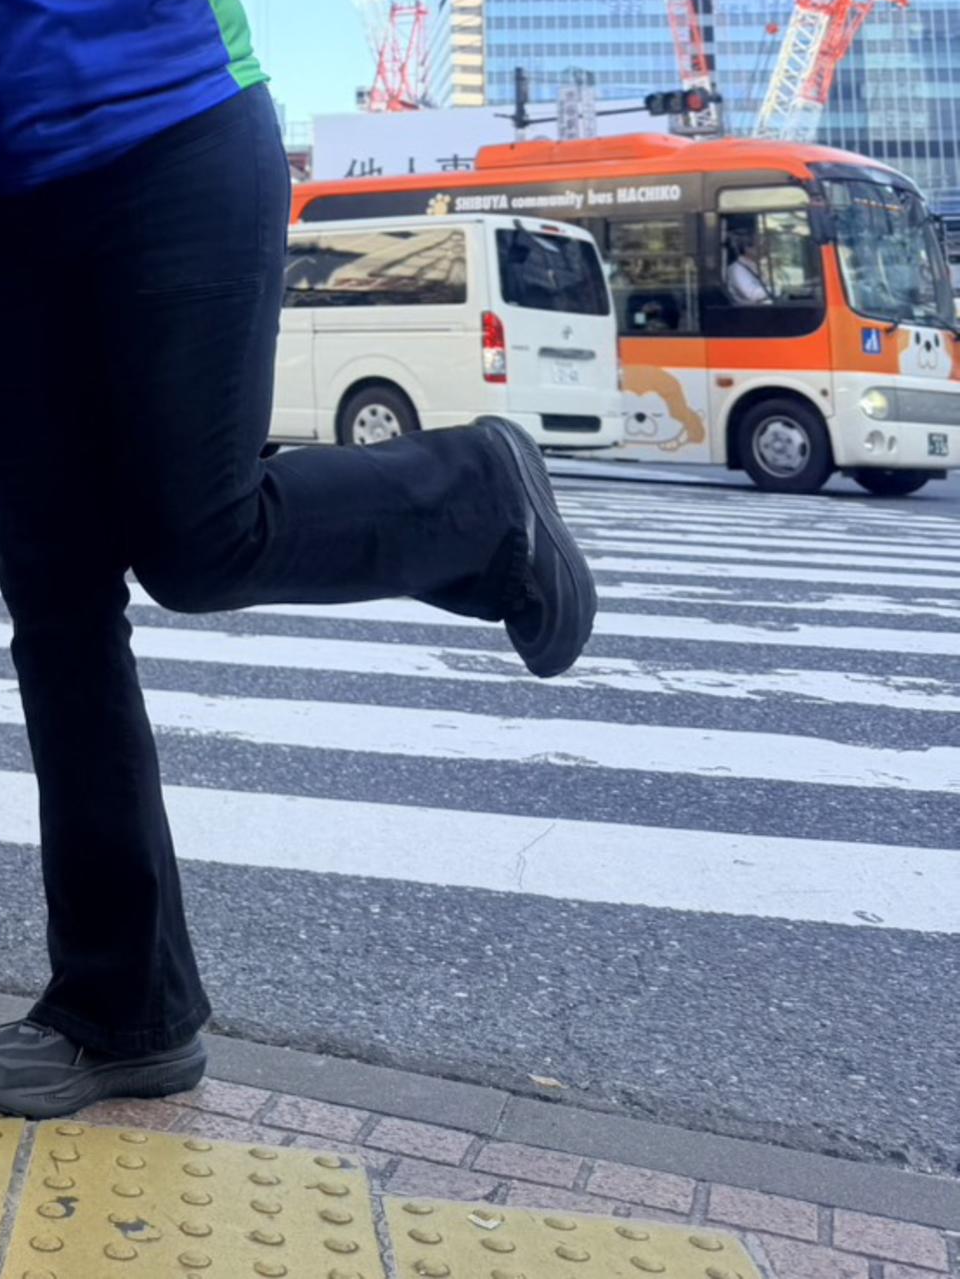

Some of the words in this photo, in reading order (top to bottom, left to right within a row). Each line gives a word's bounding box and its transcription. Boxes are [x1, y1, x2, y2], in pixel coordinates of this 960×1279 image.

[455, 194, 509, 211] SHIBUYA
[511, 190, 584, 210] community
[588, 190, 614, 205] bus
[617, 186, 681, 203] HACHIKO
